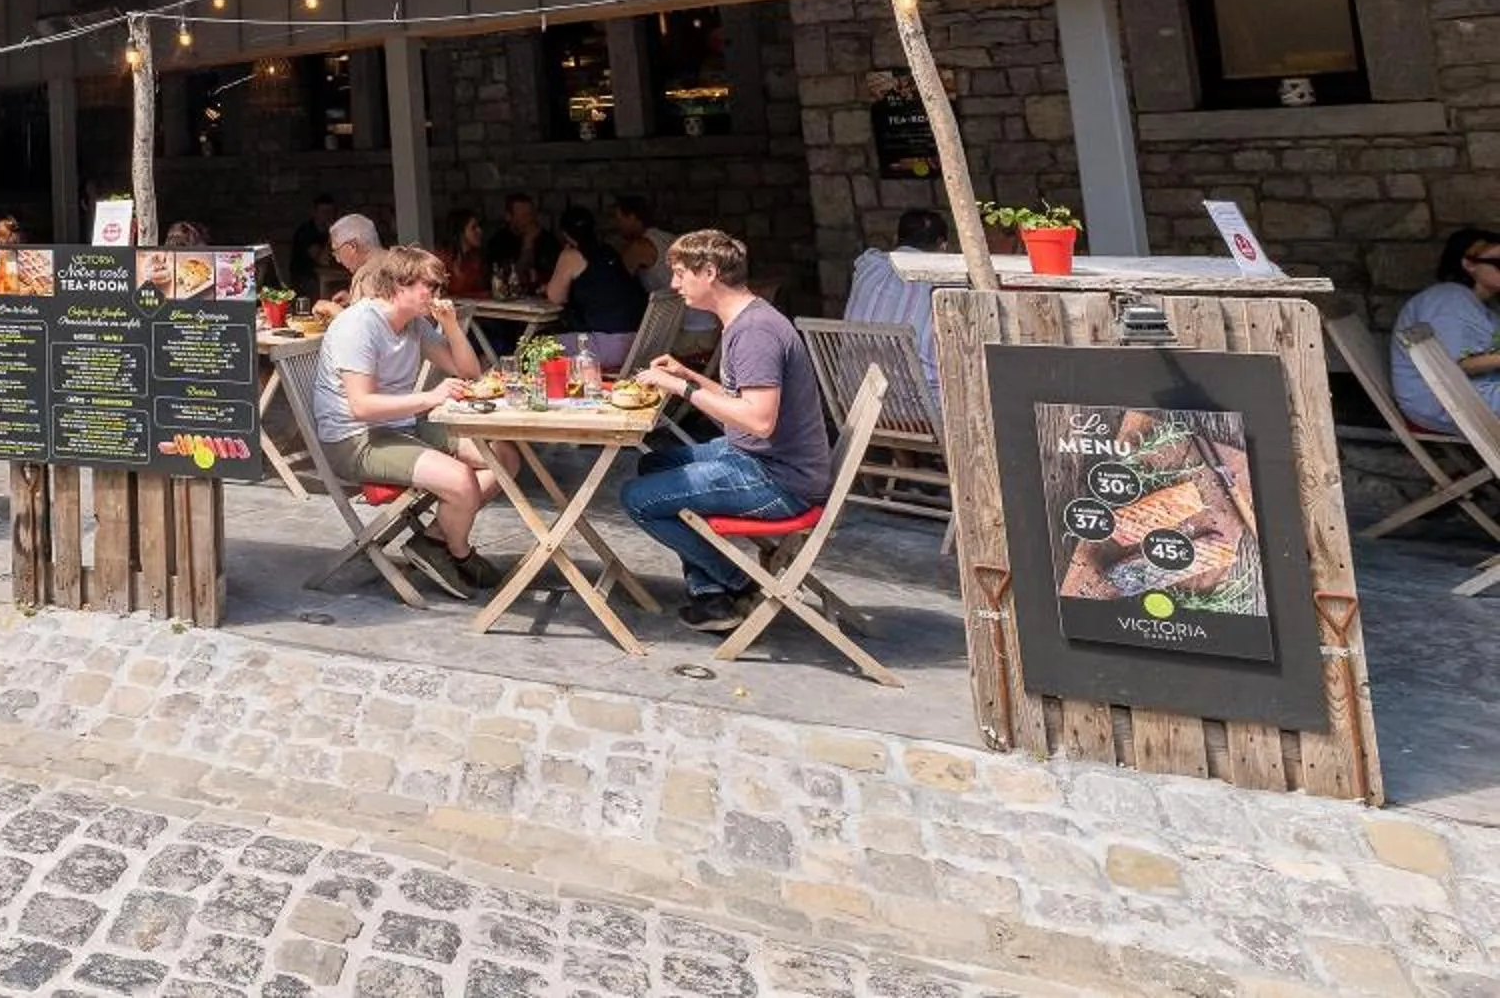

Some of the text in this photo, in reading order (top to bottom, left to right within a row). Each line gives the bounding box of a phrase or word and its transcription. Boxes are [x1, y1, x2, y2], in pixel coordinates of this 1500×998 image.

[60, 279, 129, 292] TEA-ROOM
[1069, 413, 1111, 435] Le
[1058, 437, 1131, 457] MENU
[1097, 477, 1137, 495] 30€
[1074, 513, 1109, 531] 37€
[1151, 543, 1190, 561] 45€
[1117, 617, 1207, 638] VICTORIA
